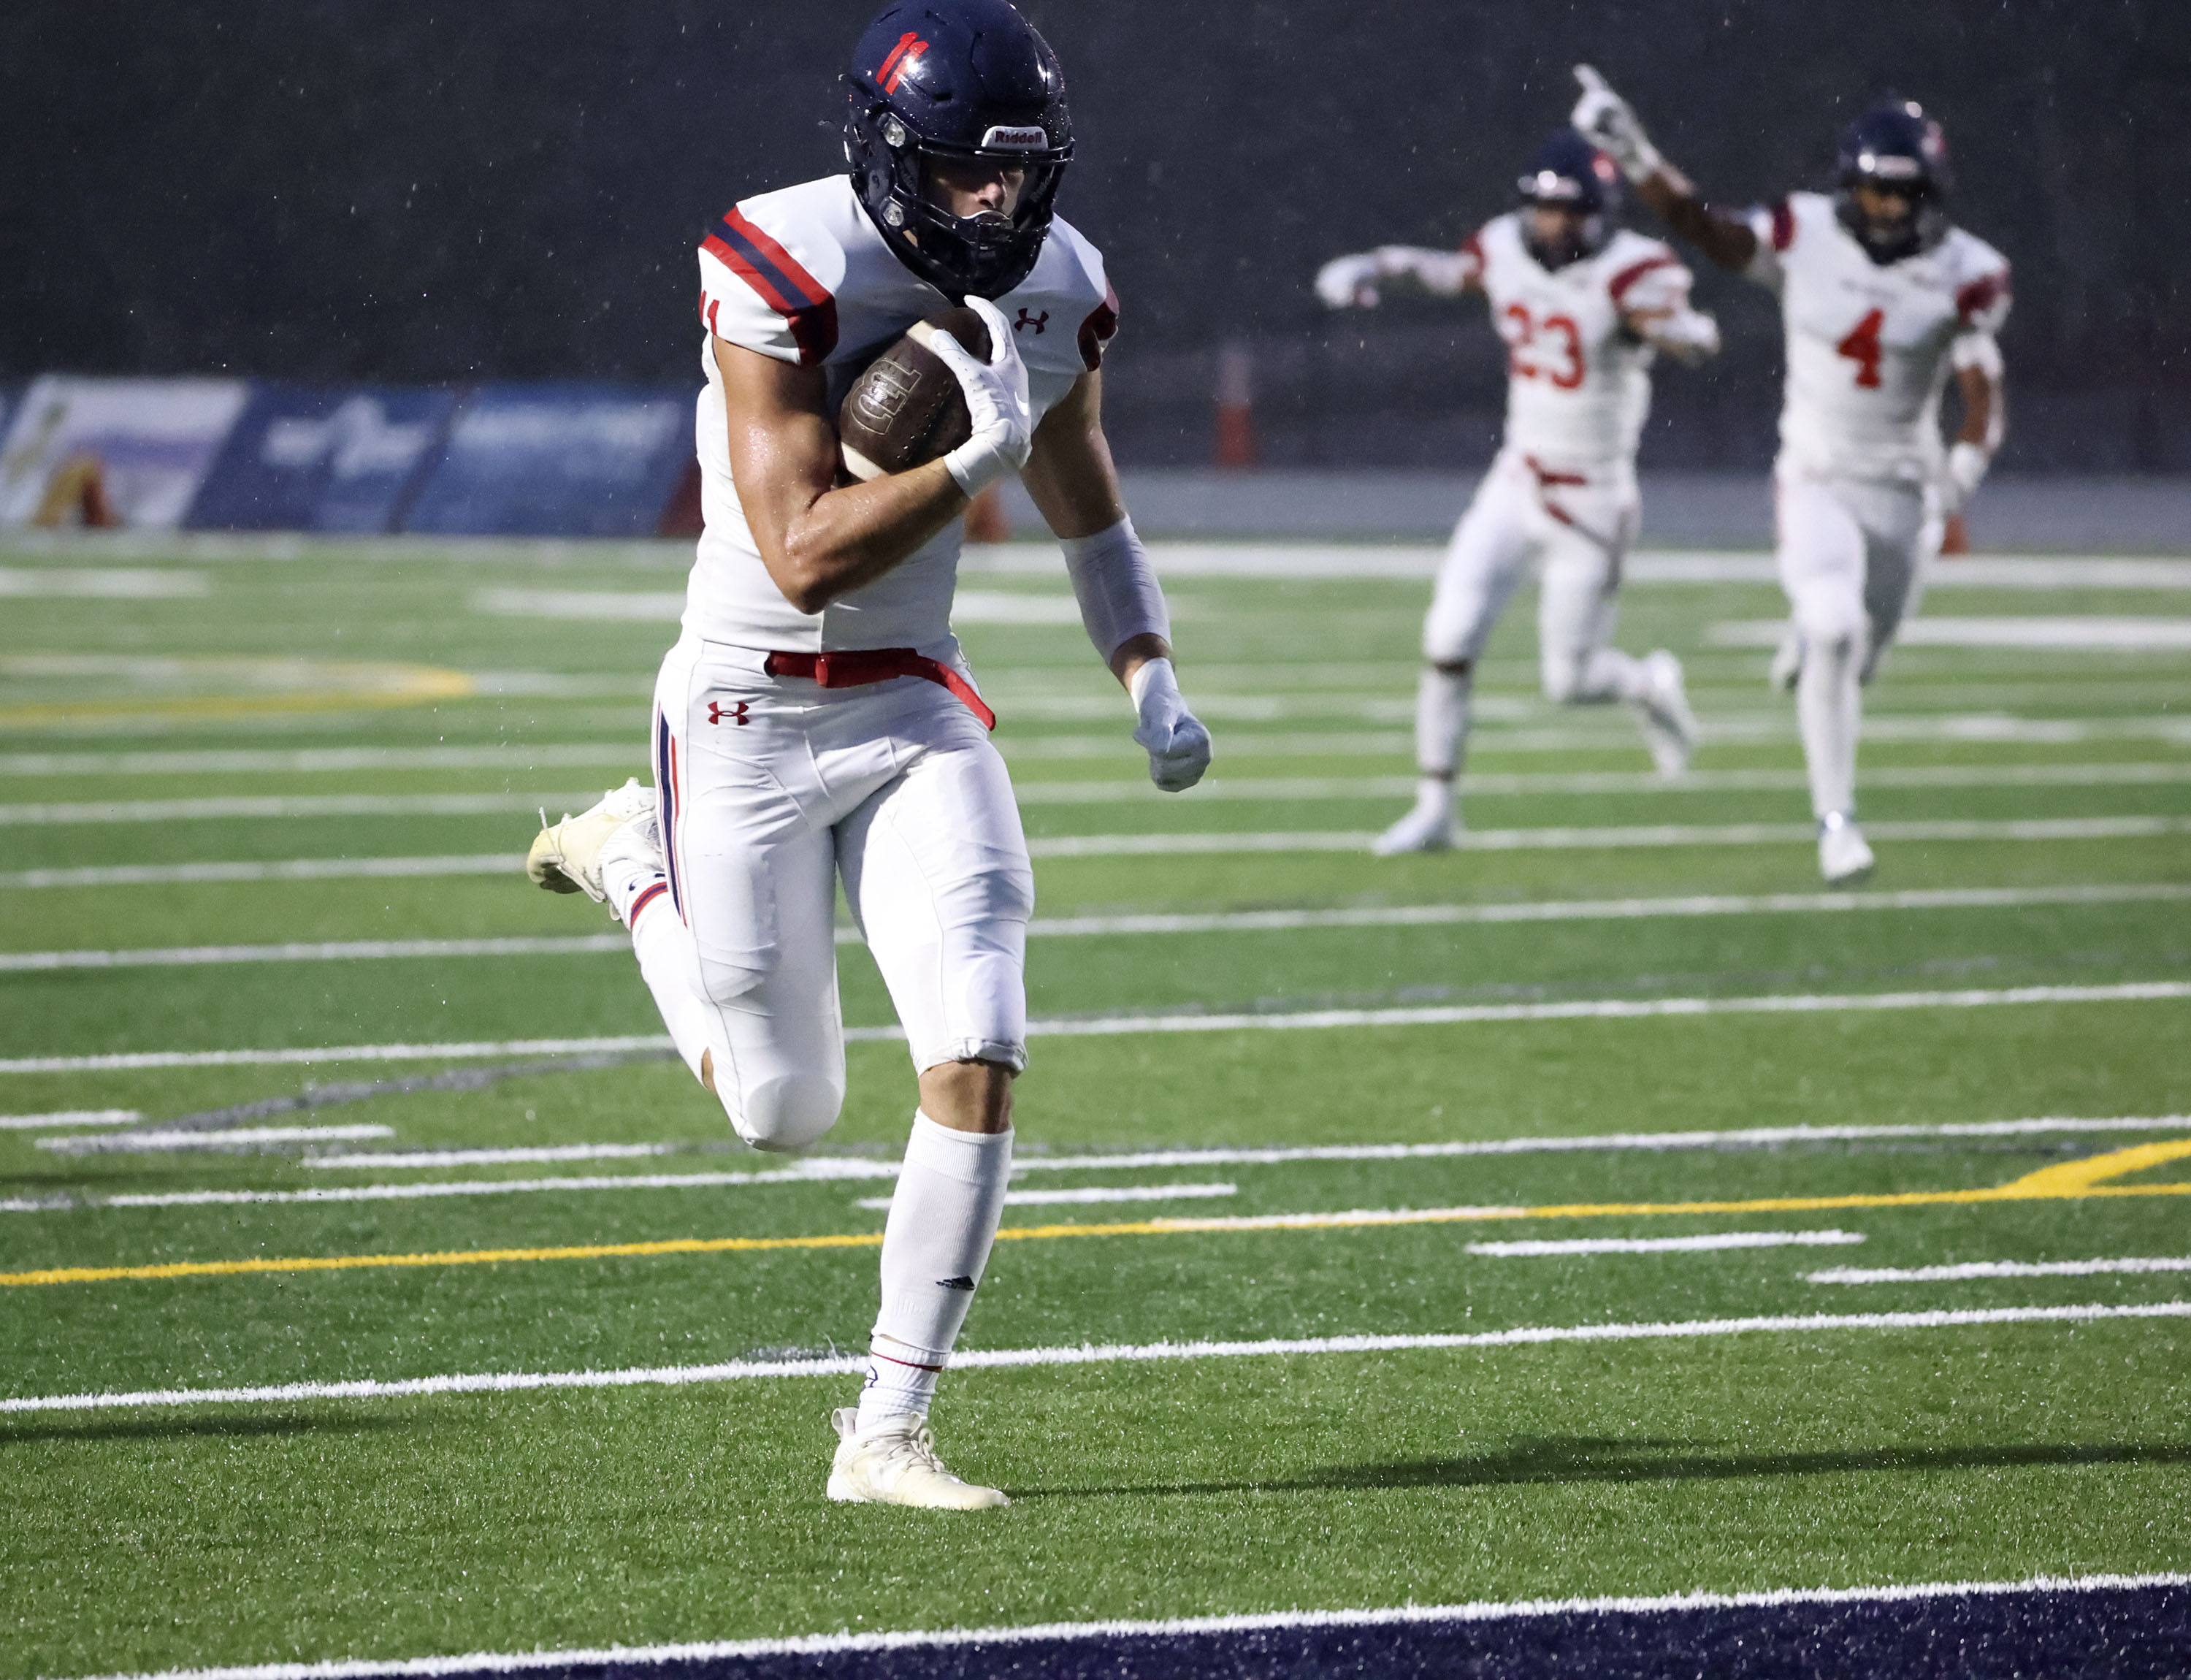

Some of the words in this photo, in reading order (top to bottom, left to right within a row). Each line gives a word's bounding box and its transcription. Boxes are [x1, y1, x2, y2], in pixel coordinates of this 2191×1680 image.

[995, 130, 1042, 144] Riddell
[1506, 301, 1585, 392] 23
[1835, 306, 1885, 389] 4
